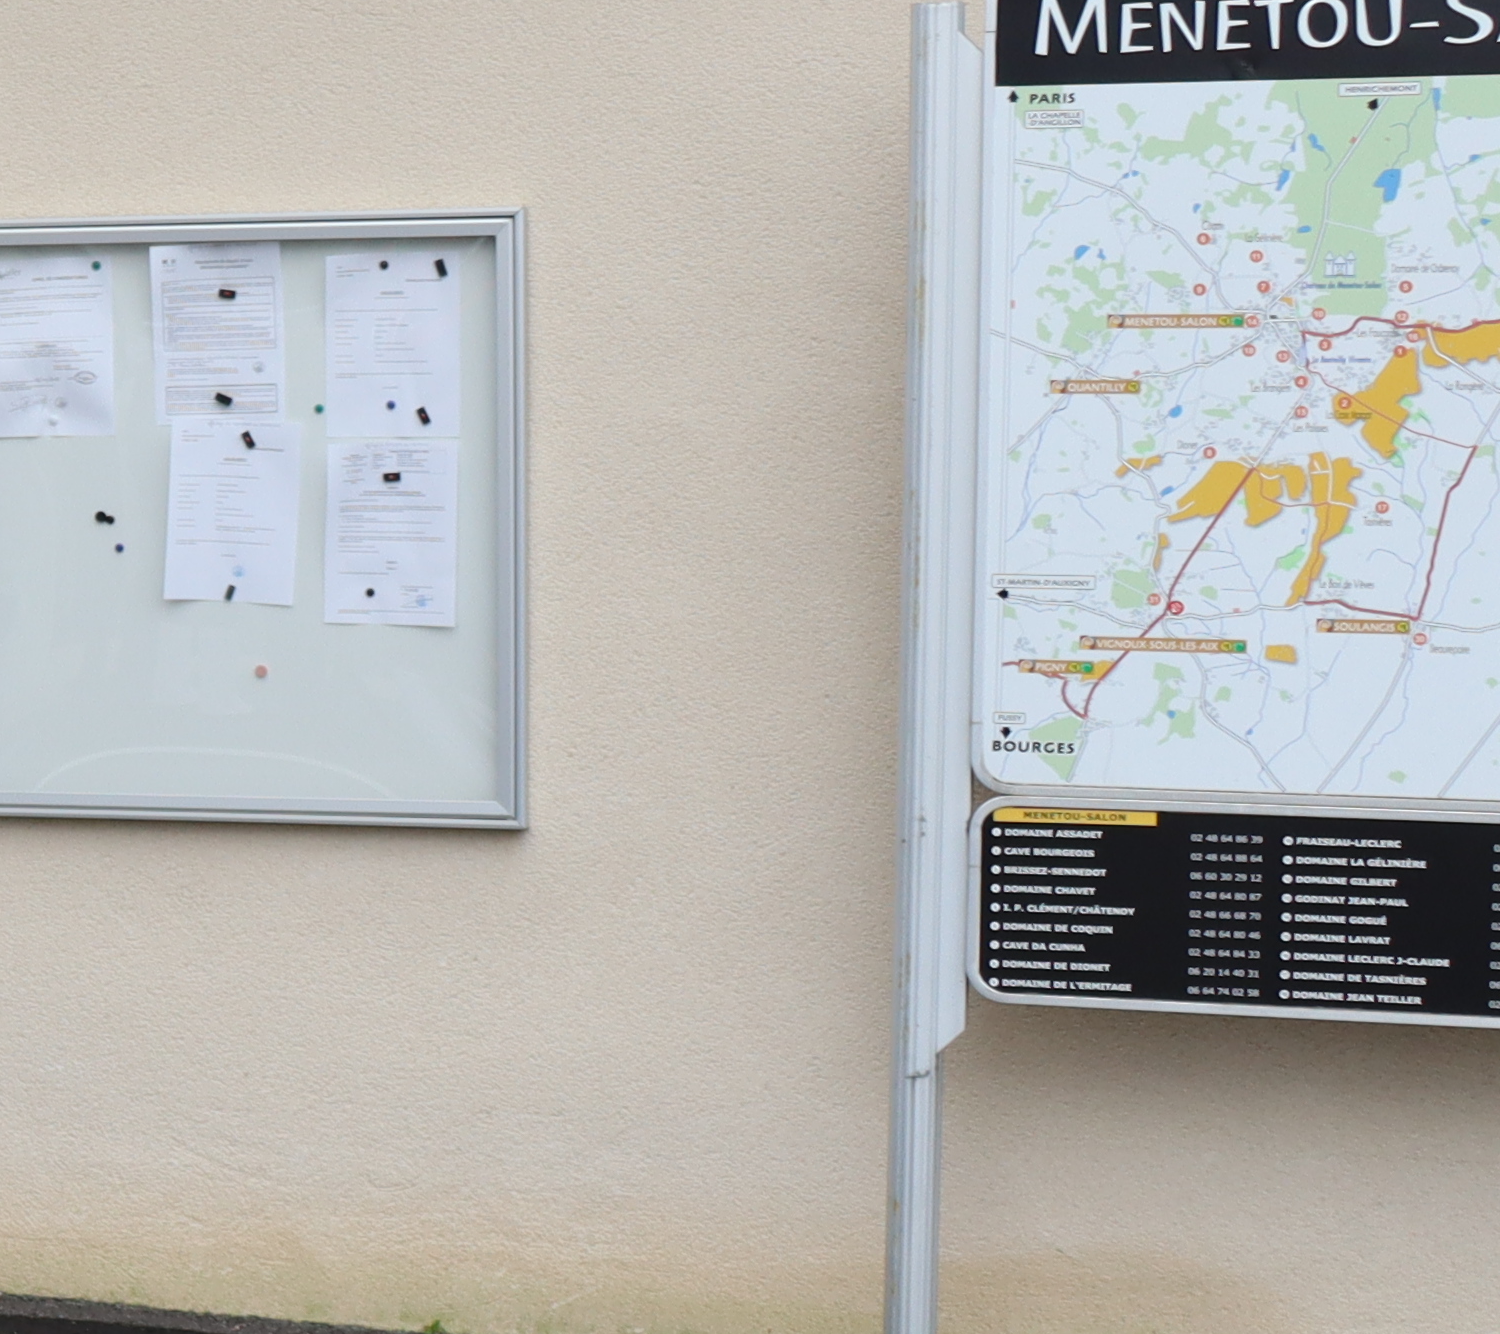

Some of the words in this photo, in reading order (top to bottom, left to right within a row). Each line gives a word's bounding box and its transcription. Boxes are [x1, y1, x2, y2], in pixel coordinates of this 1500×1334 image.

[1344, 84, 1418, 94] HENRICHEMONT
[1028, 92, 1076, 105] PARIS
[1027, 112, 1039, 120] LA
[1040, 111, 1081, 120] CHAPELLE
[1124, 317, 1218, 327] MENETOU-SALON
[1067, 381, 1127, 392] QUANTILLY
[1333, 621, 1396, 632] SOULANGIS
[1096, 639, 1219, 651] VIGNOUX-SOUS-LES-AIX
[1035, 662, 1068, 672] PIGNY
[992, 740, 1075, 754] BOURGES
[1023, 811, 1127, 821] MENETOU-SALON
[1004, 847, 1032, 856] CAVE
[1295, 856, 1348, 866] DOMAINE
[1350, 857, 1365, 867] LA
[1295, 875, 1348, 885] DOMAINE
[1294, 914, 1347, 924] DOMAINE
[1002, 922, 1052, 933] DOMAINE
[1054, 923, 1069, 933] DE
[1070, 924, 1114, 935] COQUIN
[1293, 933, 1346, 943] DOMAINE
[1348, 935, 1391, 945] LAVRAT
[1002, 941, 1030, 950] CAVE
[1293, 952, 1346, 962] DOMAINE
[1347, 954, 1395, 965] LECLERC
[1053, 961, 1068, 971] DE
[1292, 971, 1345, 982] DOMAINE
[1347, 973, 1362, 983] DE
[1053, 980, 1068, 989] DE
[1292, 991, 1345, 1001] DOMAINE
